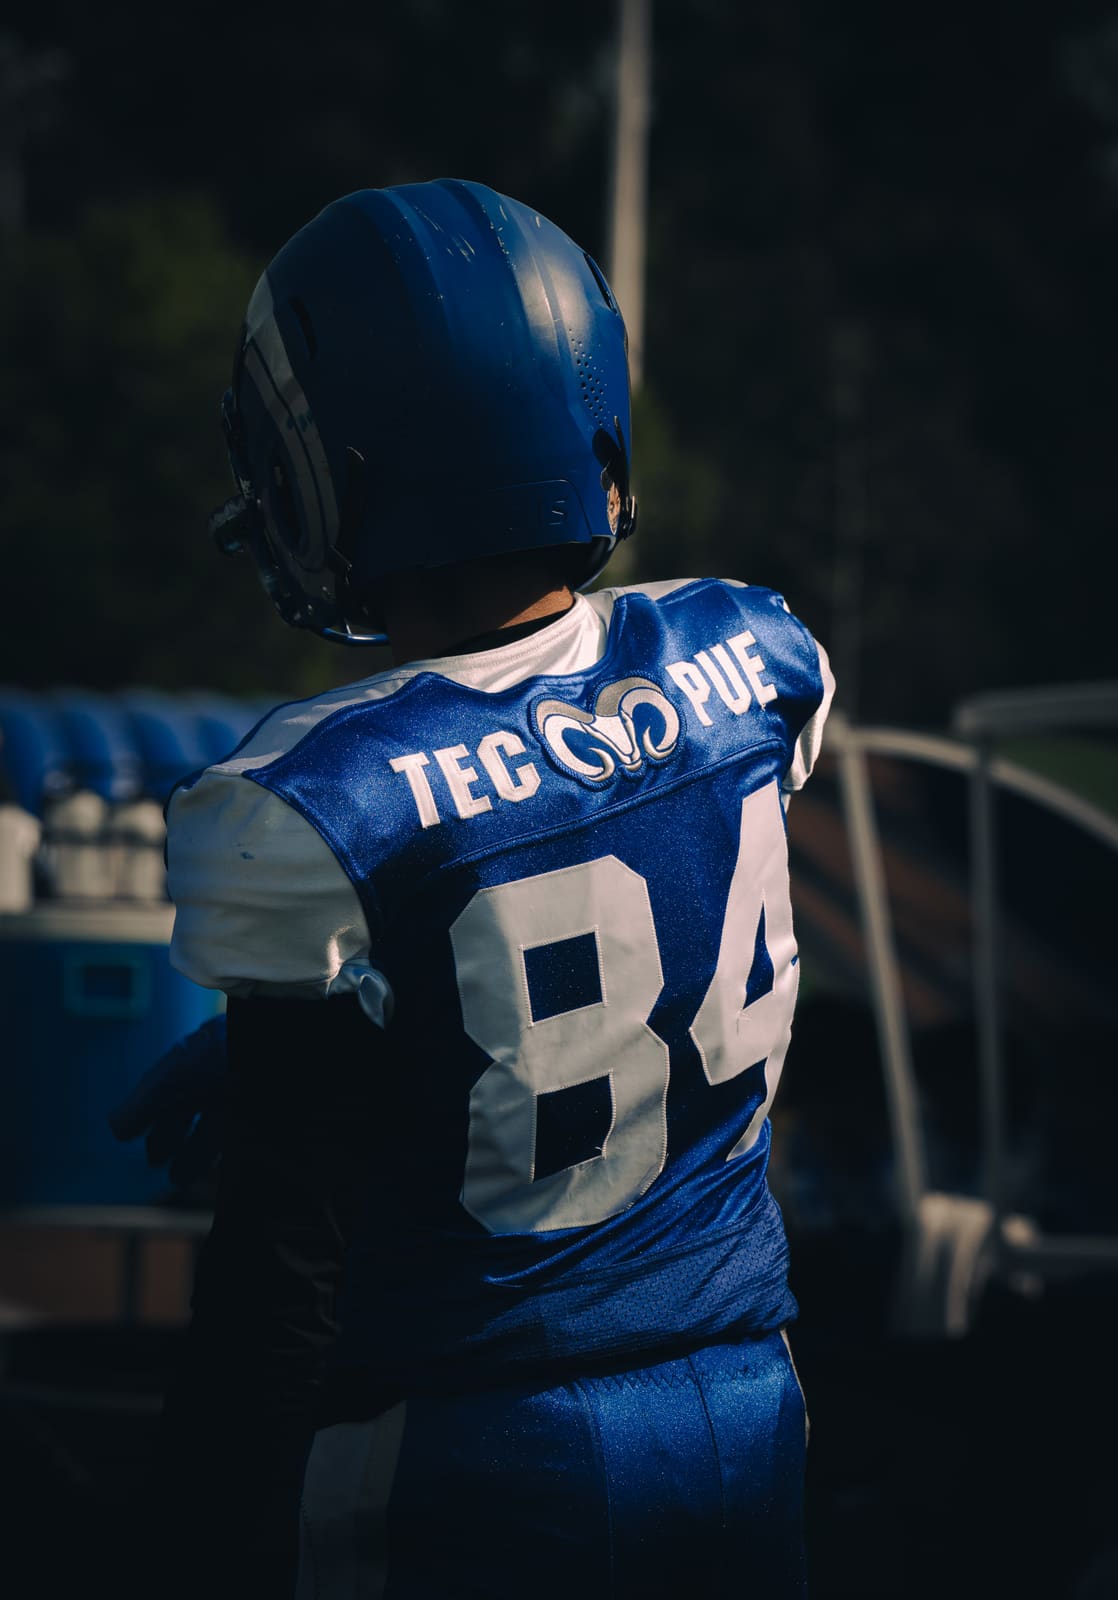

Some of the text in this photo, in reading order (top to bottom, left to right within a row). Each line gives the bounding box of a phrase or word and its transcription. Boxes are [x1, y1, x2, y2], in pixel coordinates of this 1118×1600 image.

[390, 631, 778, 828] TEC PUE
[449, 777, 800, 1234] 84
